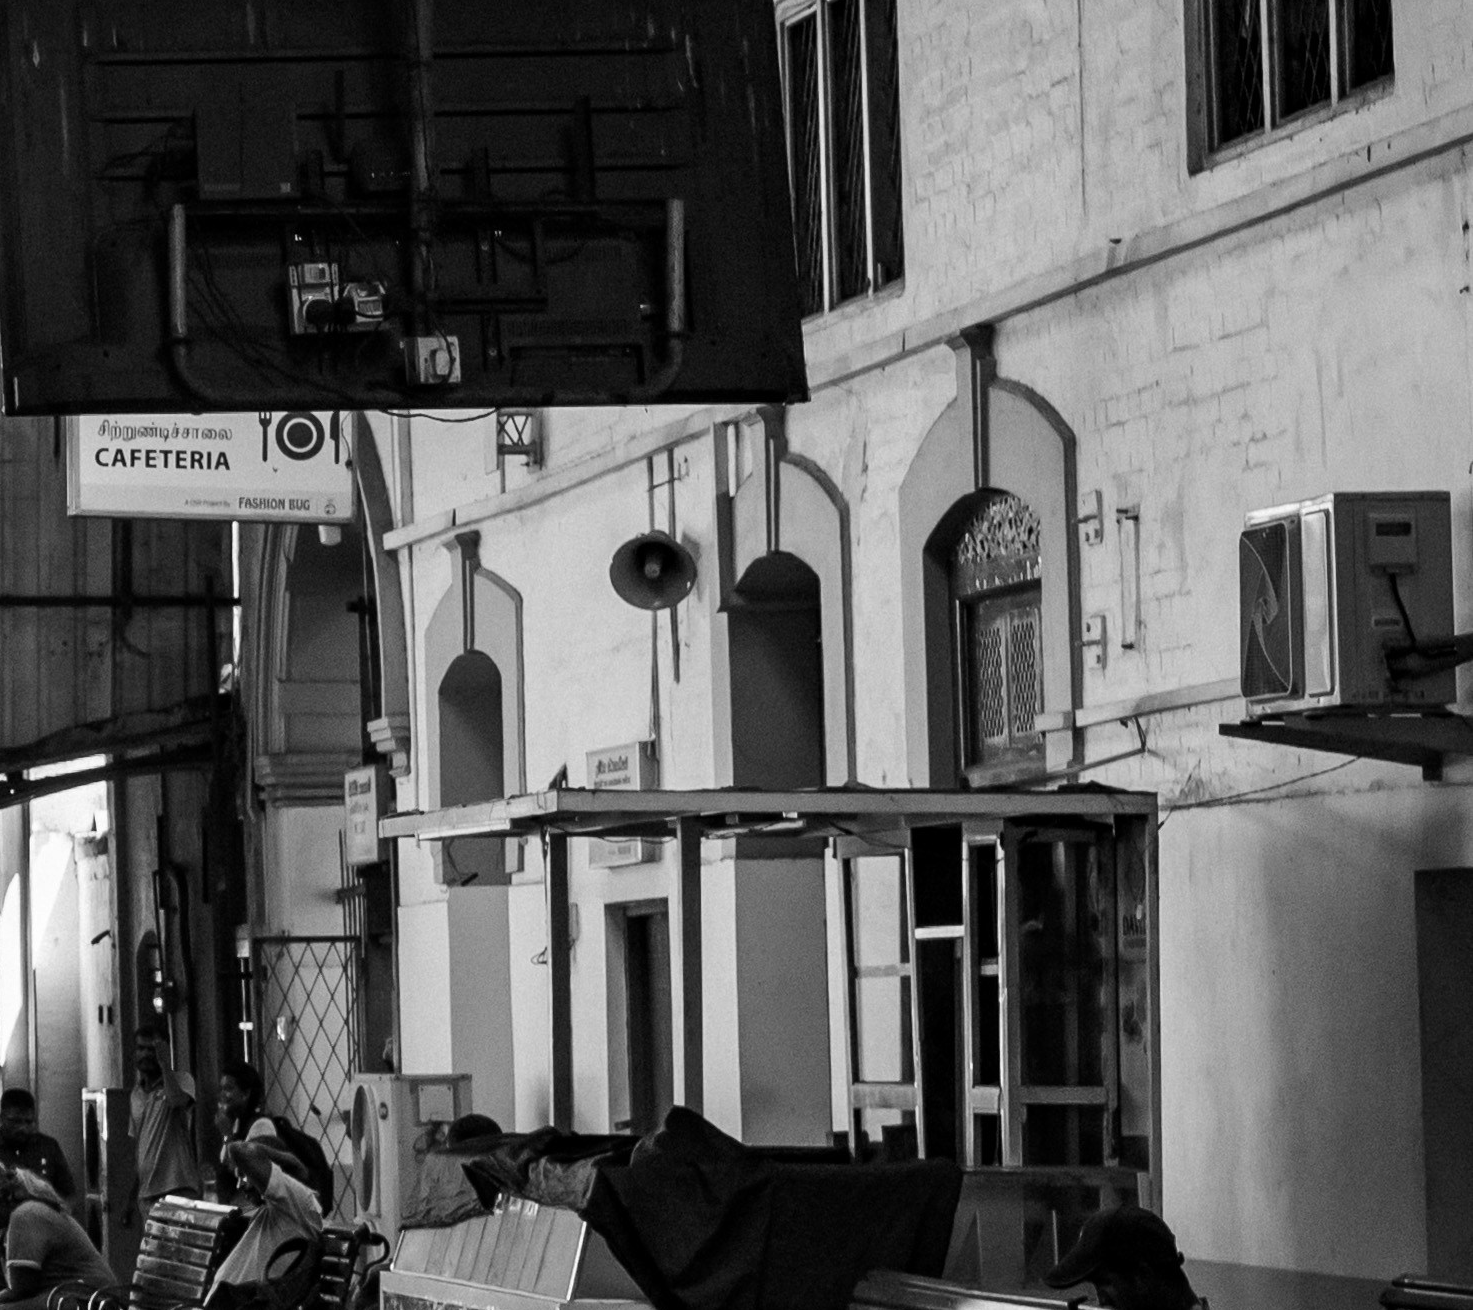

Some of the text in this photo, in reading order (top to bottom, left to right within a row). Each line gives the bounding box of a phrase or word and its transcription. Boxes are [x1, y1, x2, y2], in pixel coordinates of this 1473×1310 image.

[94, 447, 231, 472] CAFETERIA
[238, 496, 285, 511] FASHION
[288, 498, 311, 512] BUG
